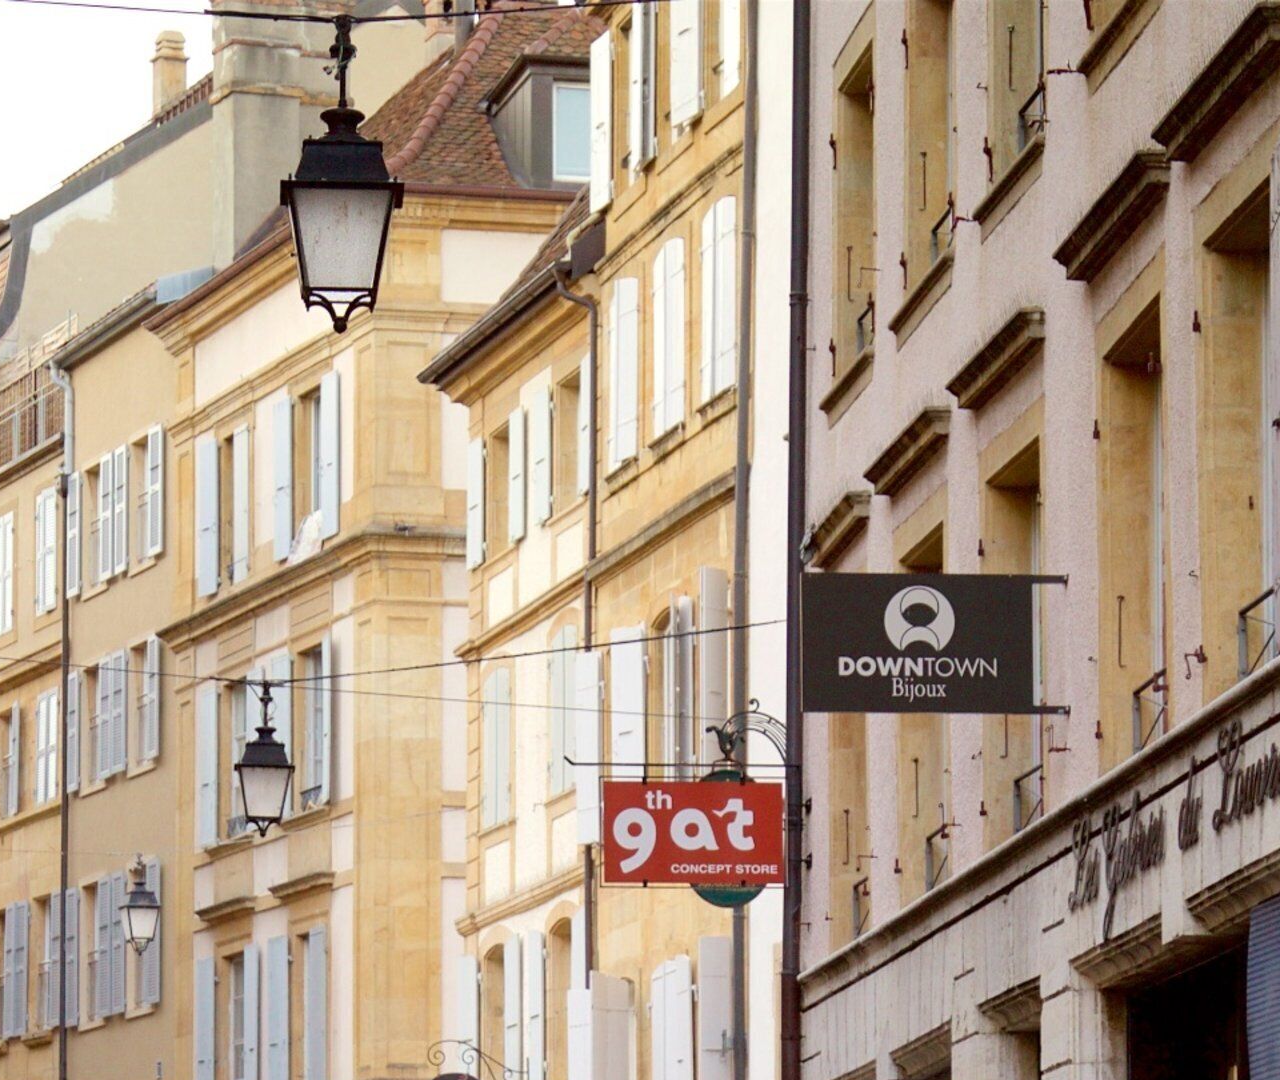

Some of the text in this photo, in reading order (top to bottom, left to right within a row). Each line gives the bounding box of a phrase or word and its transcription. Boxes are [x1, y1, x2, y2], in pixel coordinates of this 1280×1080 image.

[838, 656, 998, 678] DOWNTOWN
[891, 677, 947, 703] Bijoux
[670, 863, 778, 875] CONCEPT STORE
